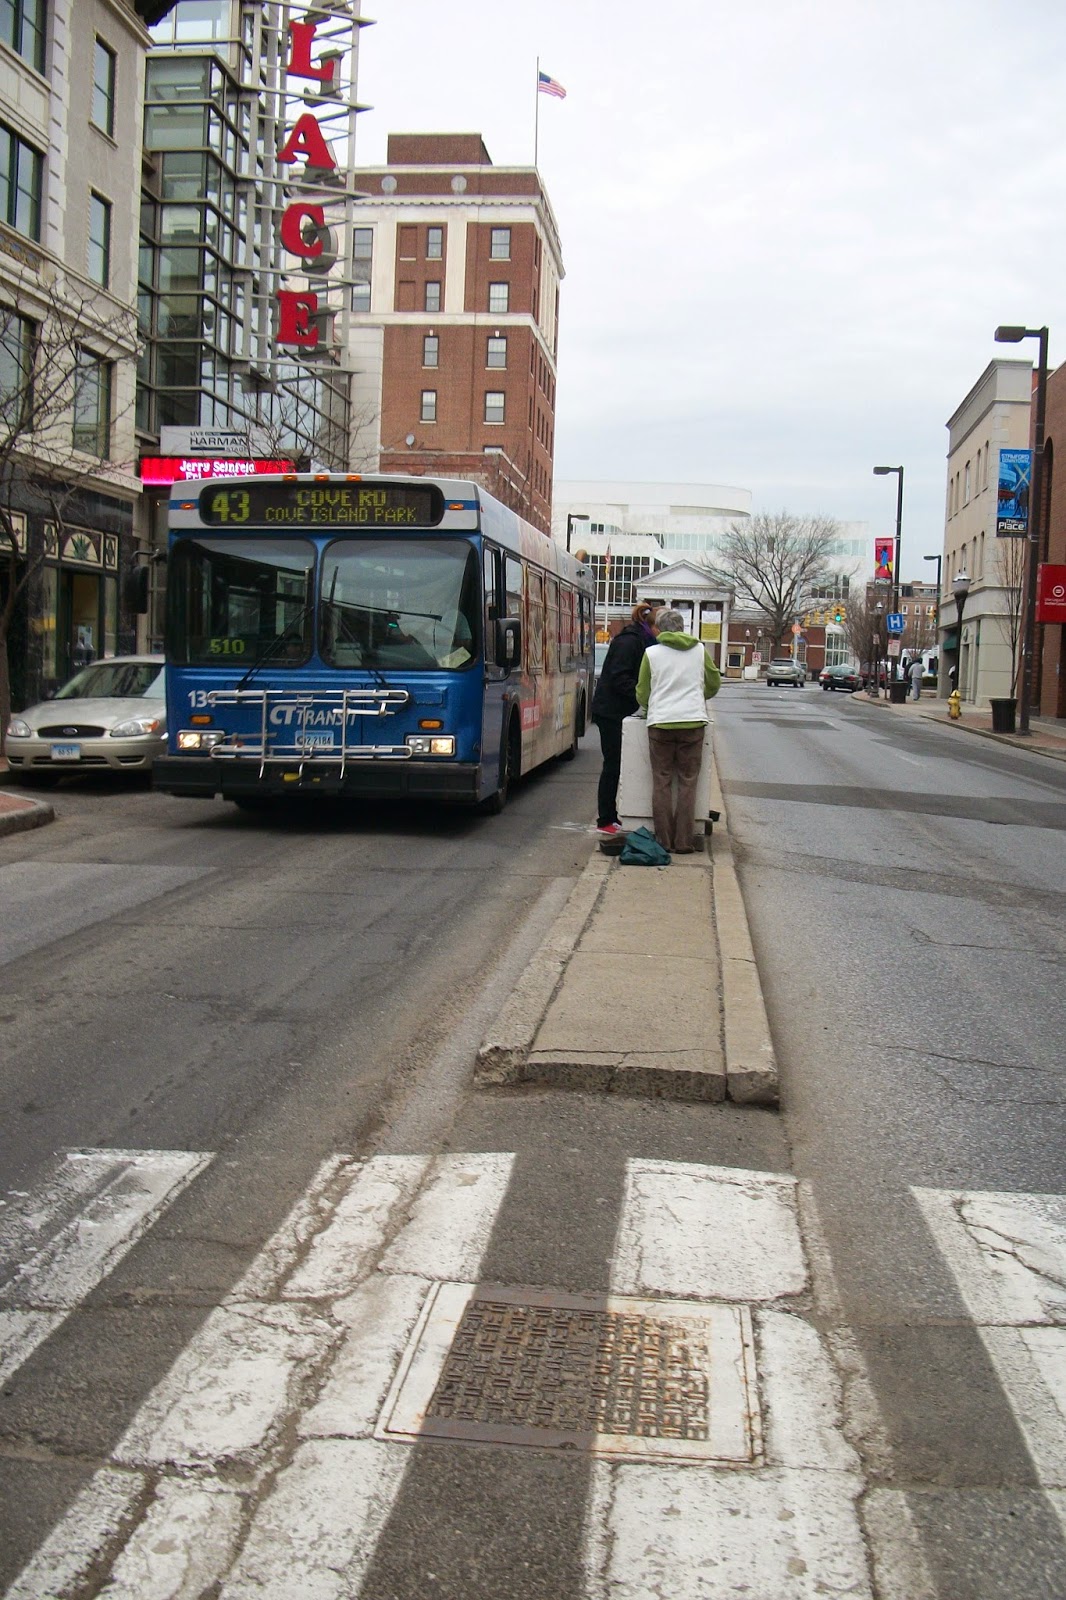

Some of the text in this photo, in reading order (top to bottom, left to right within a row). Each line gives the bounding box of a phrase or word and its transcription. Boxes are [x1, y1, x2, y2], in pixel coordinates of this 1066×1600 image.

[276, 20, 336, 346] LACE
[190, 437, 249, 446] HARMAN
[179, 460, 255, 473] Jerry Seinfeld
[297, 489, 387, 507] COVE RD
[211, 490, 250, 522] 43
[265, 507, 417, 522] COVE ISLAND PARK
[890, 615, 901, 629] H
[210, 638, 245, 654] 510
